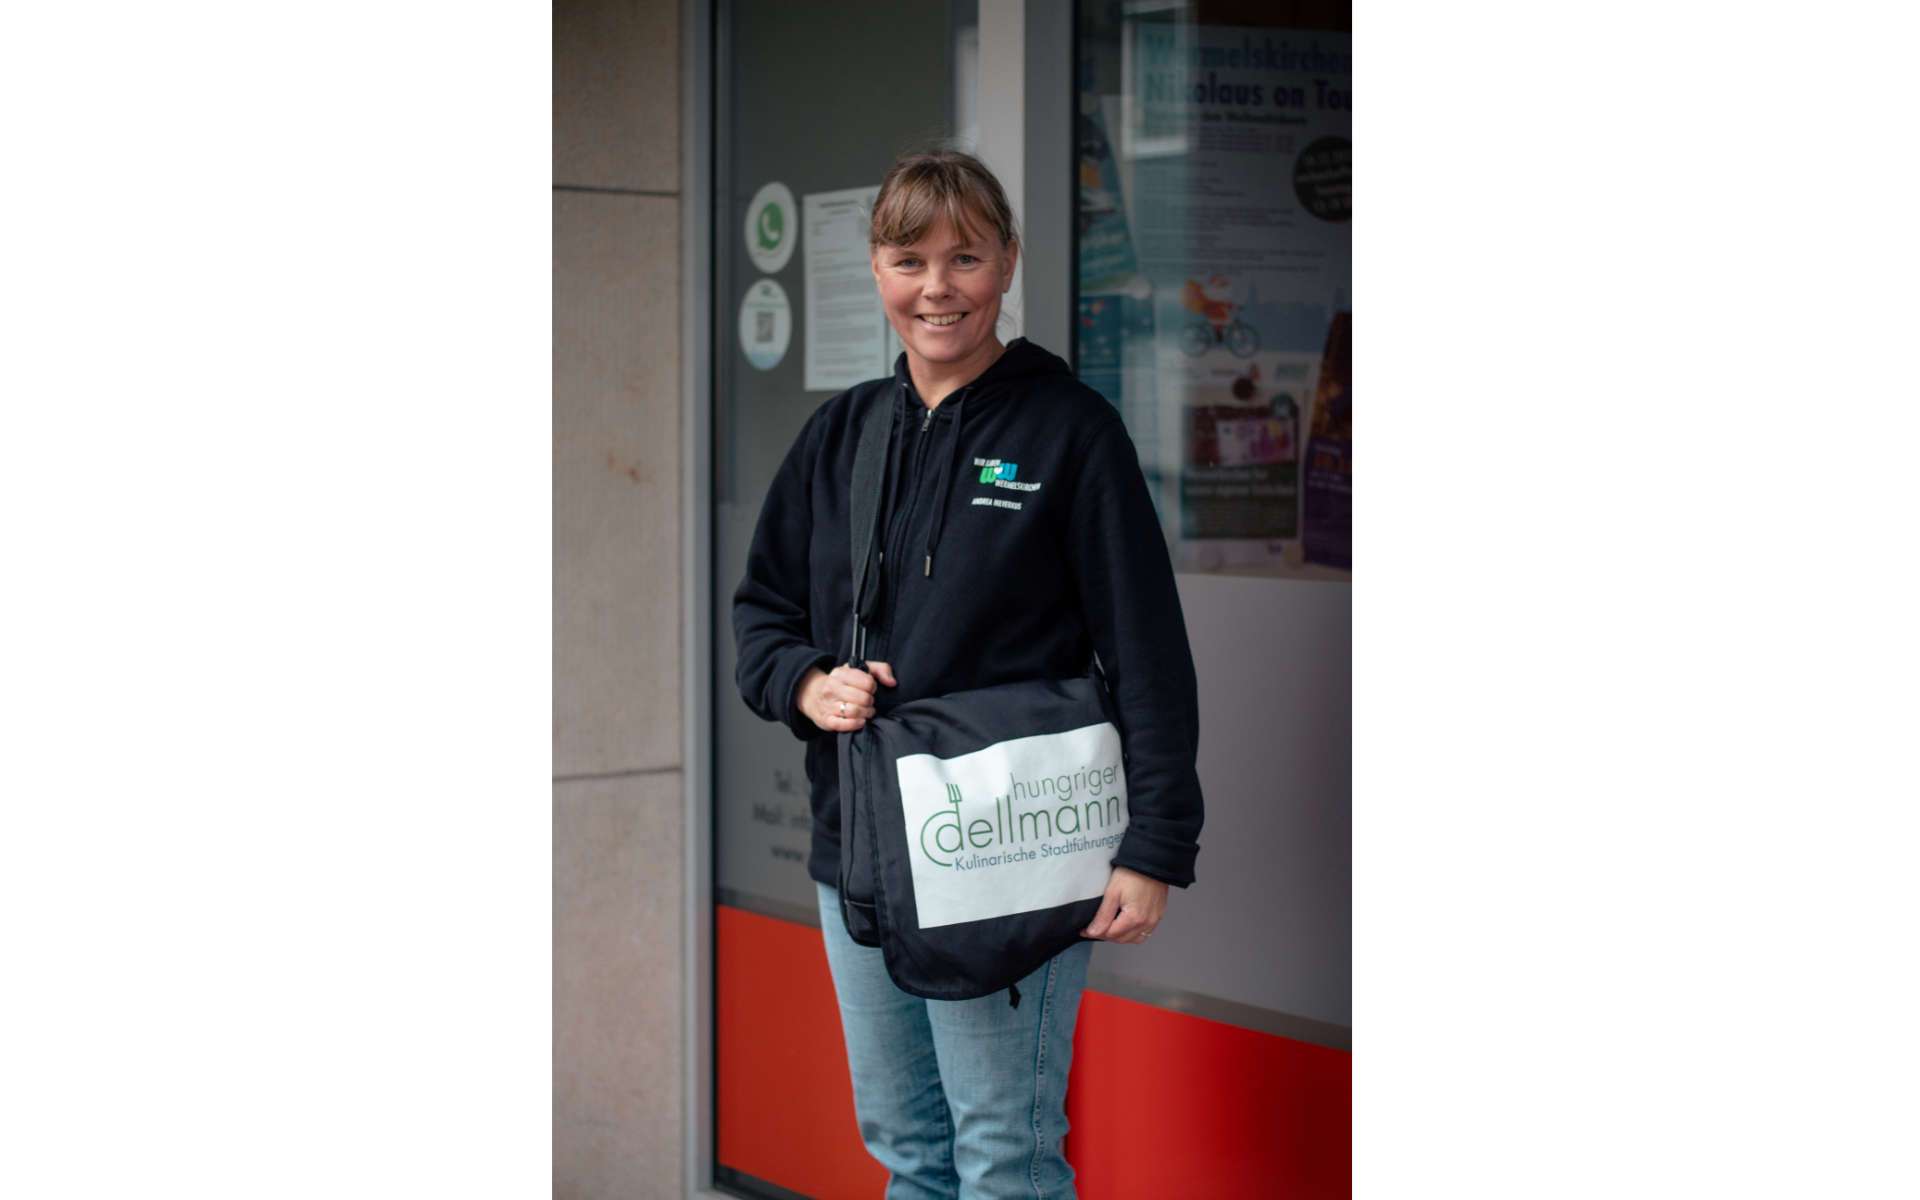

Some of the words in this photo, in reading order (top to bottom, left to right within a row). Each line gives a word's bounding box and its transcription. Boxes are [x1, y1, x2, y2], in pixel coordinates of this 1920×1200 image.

[1272, 85, 1306, 109] on
[1009, 763, 1119, 801] hungriger
[934, 784, 1121, 853] dellmann
[954, 846, 1037, 871] Kulinarische
